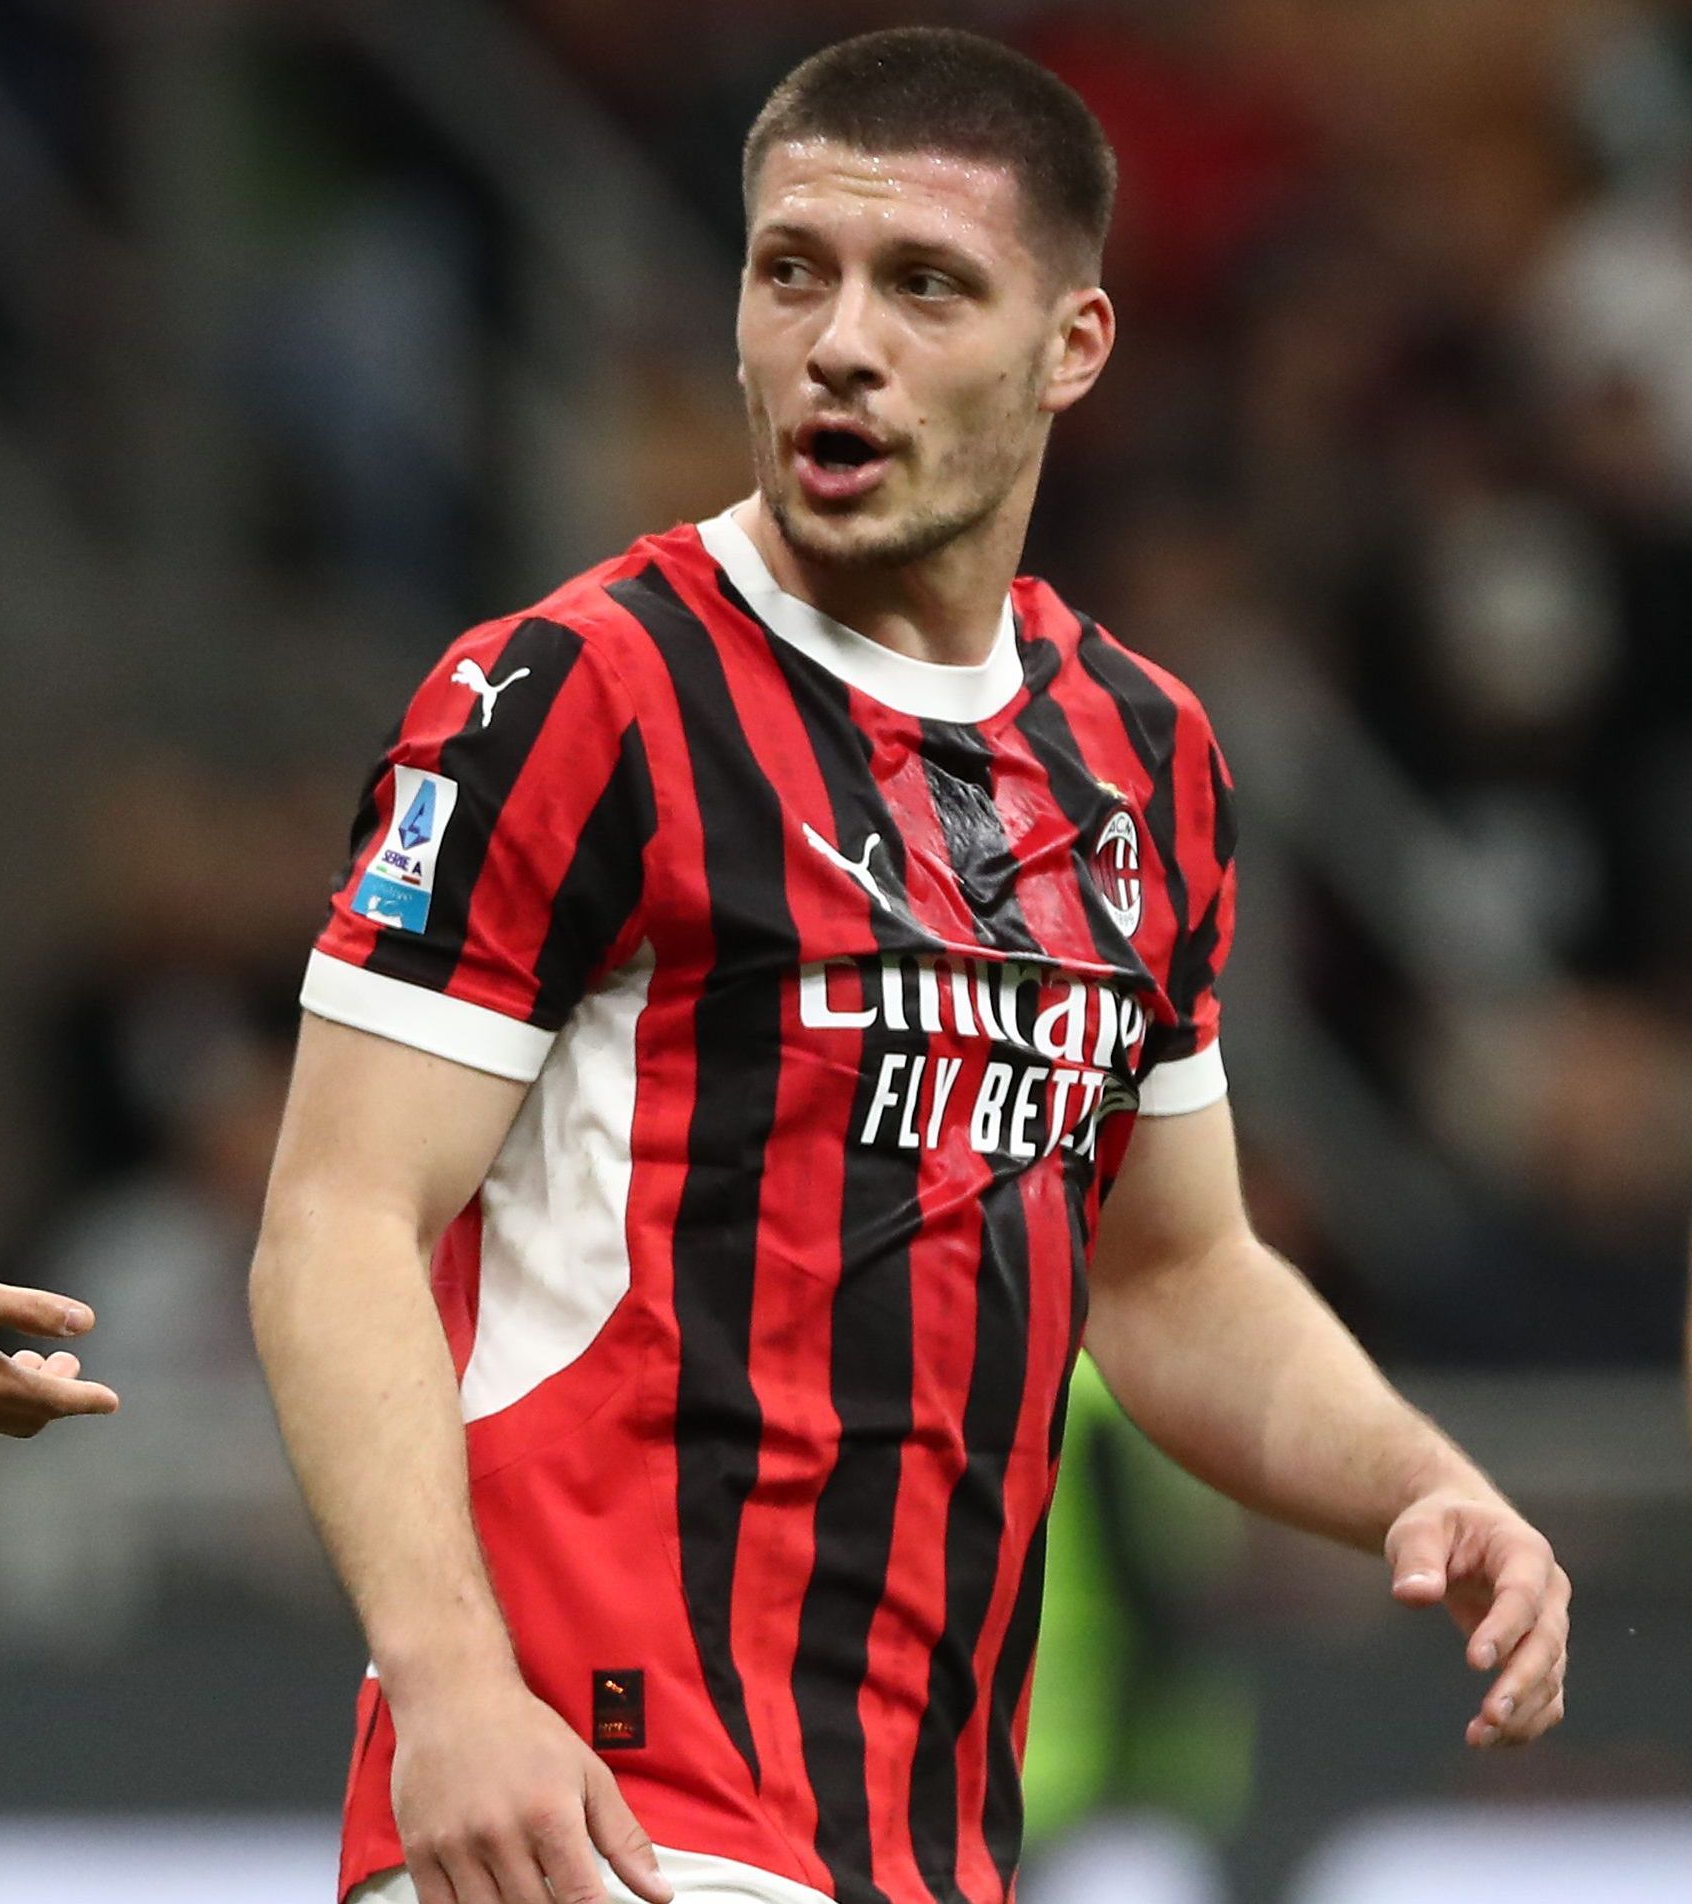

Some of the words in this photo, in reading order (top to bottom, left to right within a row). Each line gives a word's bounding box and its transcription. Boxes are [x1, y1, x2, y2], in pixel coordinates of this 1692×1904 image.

[412, 861, 423, 877] A
[860, 1054, 962, 1151] FLY
[969, 1061, 1109, 1162] BETT
